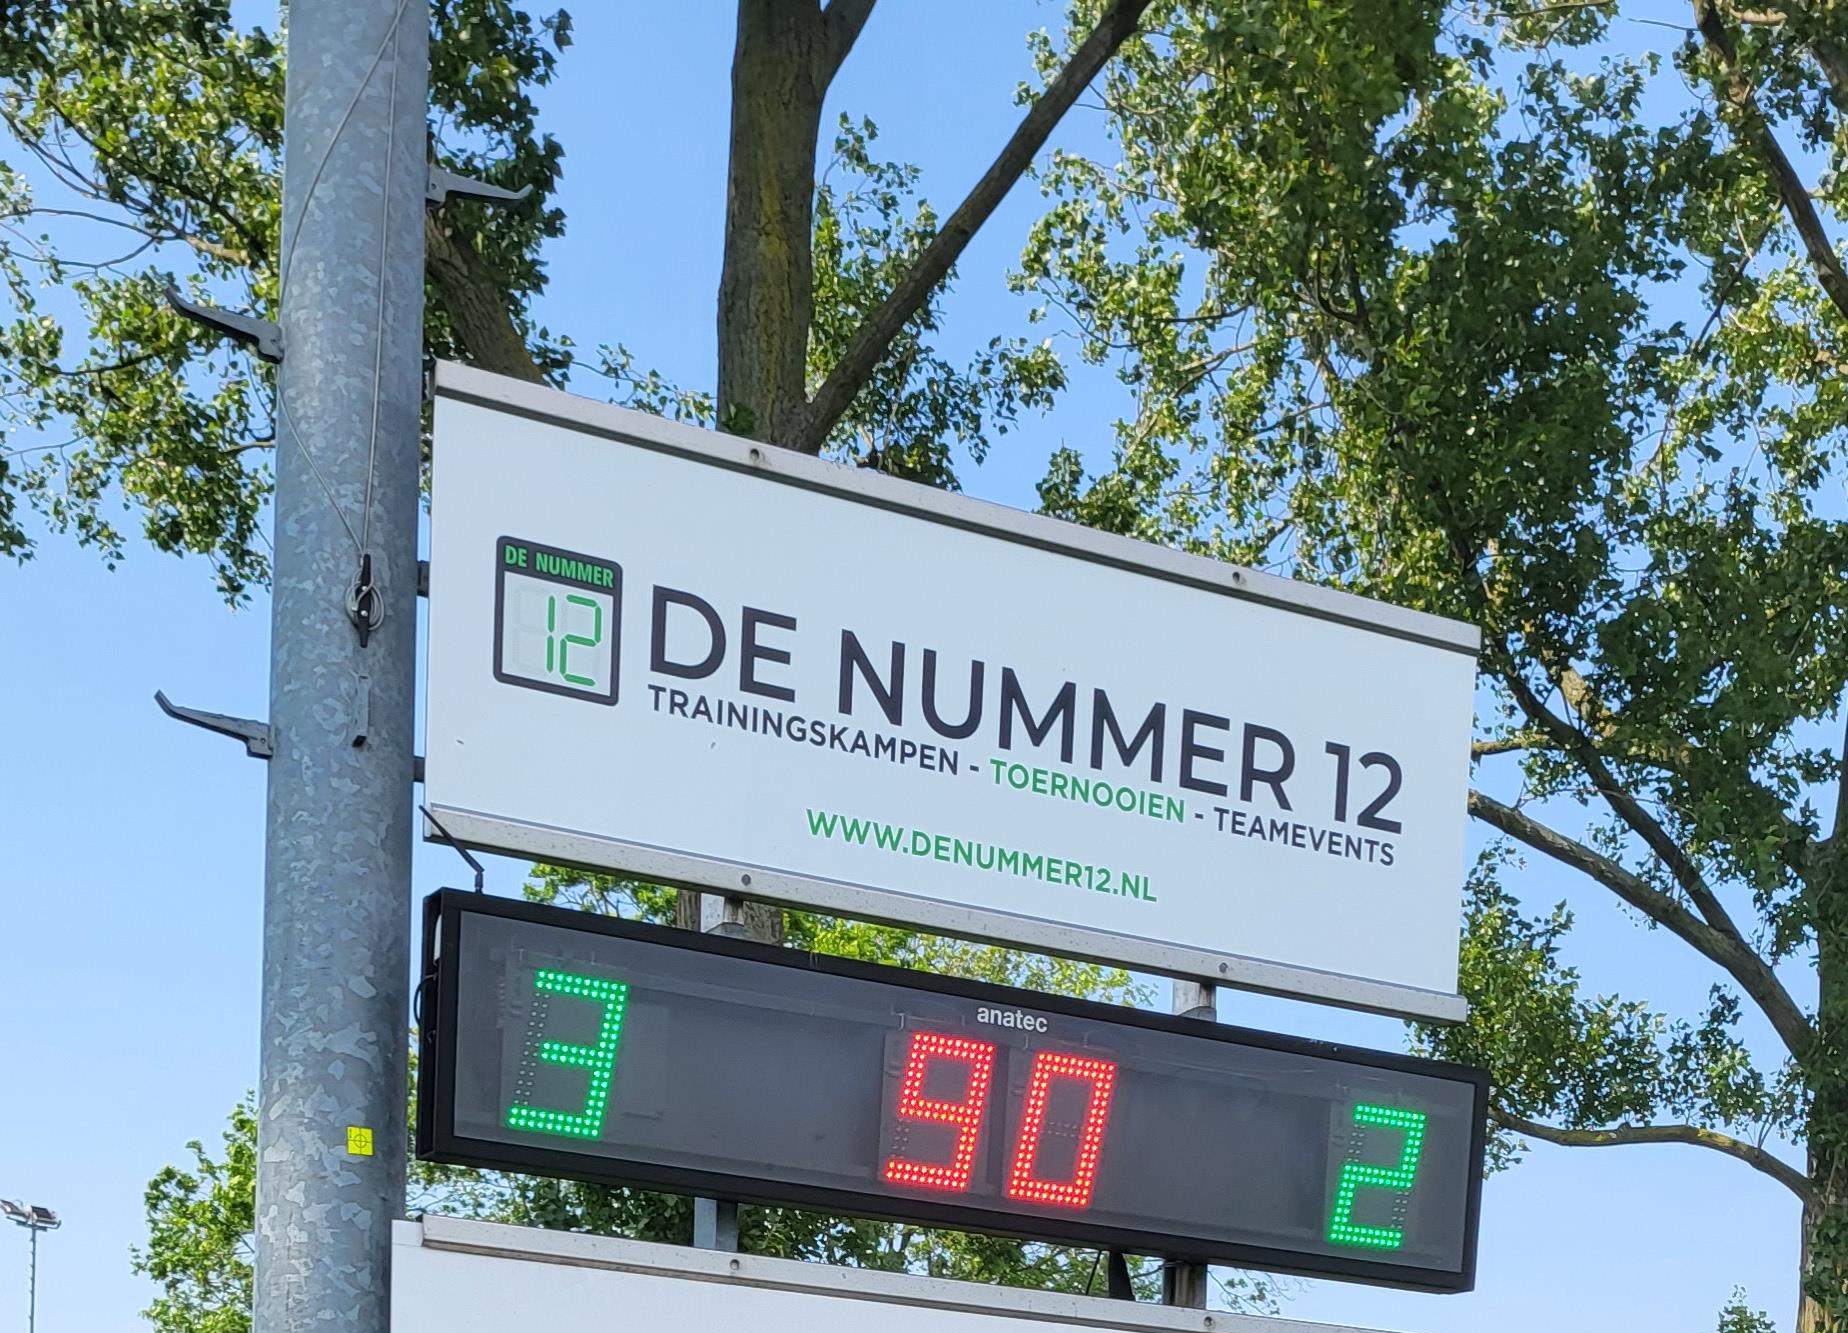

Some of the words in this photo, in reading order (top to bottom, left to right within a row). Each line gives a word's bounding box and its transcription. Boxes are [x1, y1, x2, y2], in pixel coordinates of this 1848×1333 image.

[505, 544, 528, 568] DE
[536, 552, 614, 588] NUMMER
[546, 593, 603, 687] 12
[650, 584, 797, 703] DE
[838, 629, 1296, 811] NUMMER
[1325, 740, 1403, 835] 12
[647, 684, 959, 776] TRAININGSKAMPEN
[990, 758, 1185, 824] TOERNOOIEN
[1213, 807, 1395, 866] TEAMEVENTS
[806, 808, 1158, 903] WWW.DENUMMER12.NL
[976, 1007, 1048, 1033] anatec
[507, 968, 629, 1139] 3
[884, 1032, 1117, 1207] 90
[1328, 1104, 1428, 1249] 2
